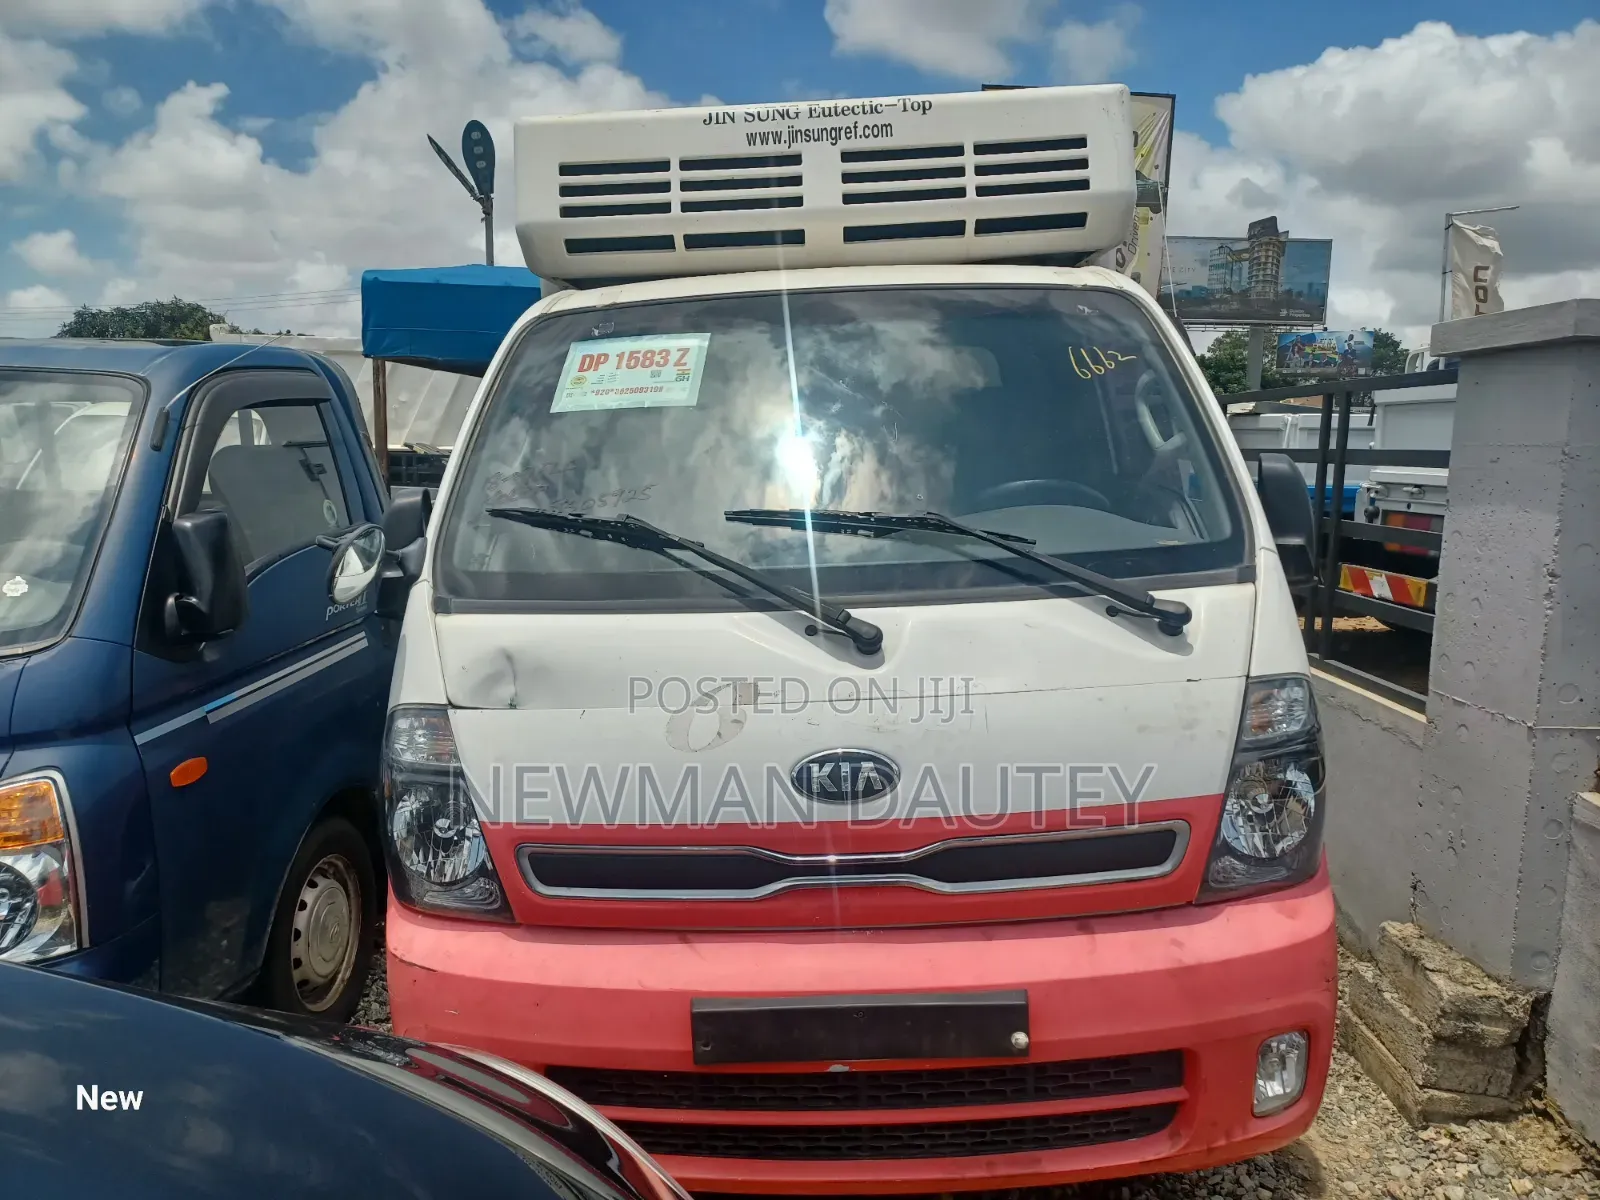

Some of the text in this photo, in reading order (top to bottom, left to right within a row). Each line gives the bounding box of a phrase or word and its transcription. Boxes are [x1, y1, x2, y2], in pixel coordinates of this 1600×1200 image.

[702, 110, 736, 126] JIN
[743, 105, 801, 124] SUNG
[745, 120, 894, 149] www.jinsungref.com
[577, 347, 691, 373] DP 1583 Z
[1068, 346, 1137, 379] 6662
[809, 761, 883, 793] KIA
